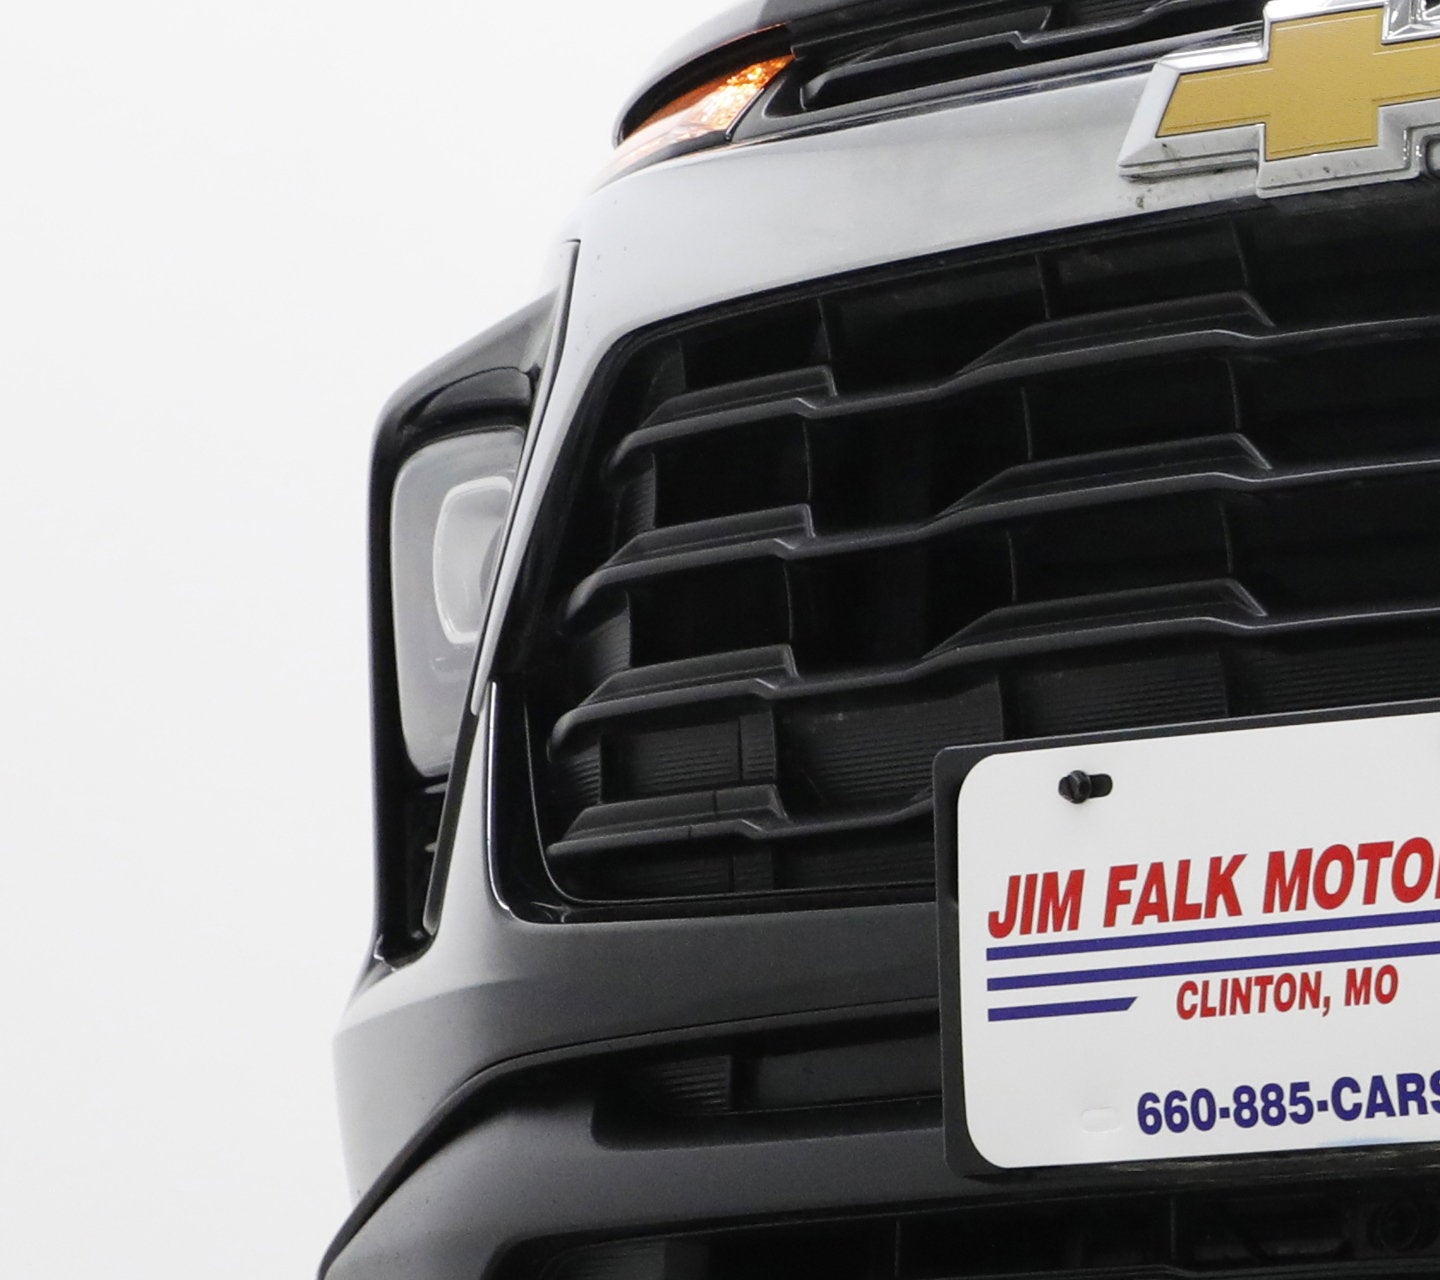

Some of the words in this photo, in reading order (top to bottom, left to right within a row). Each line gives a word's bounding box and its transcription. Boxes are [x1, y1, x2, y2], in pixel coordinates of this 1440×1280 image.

[987, 868, 1086, 939] JIM
[1103, 853, 1248, 928] FALK
[1176, 970, 1332, 1020] CLINTON,
[1344, 963, 1399, 1006] MO
